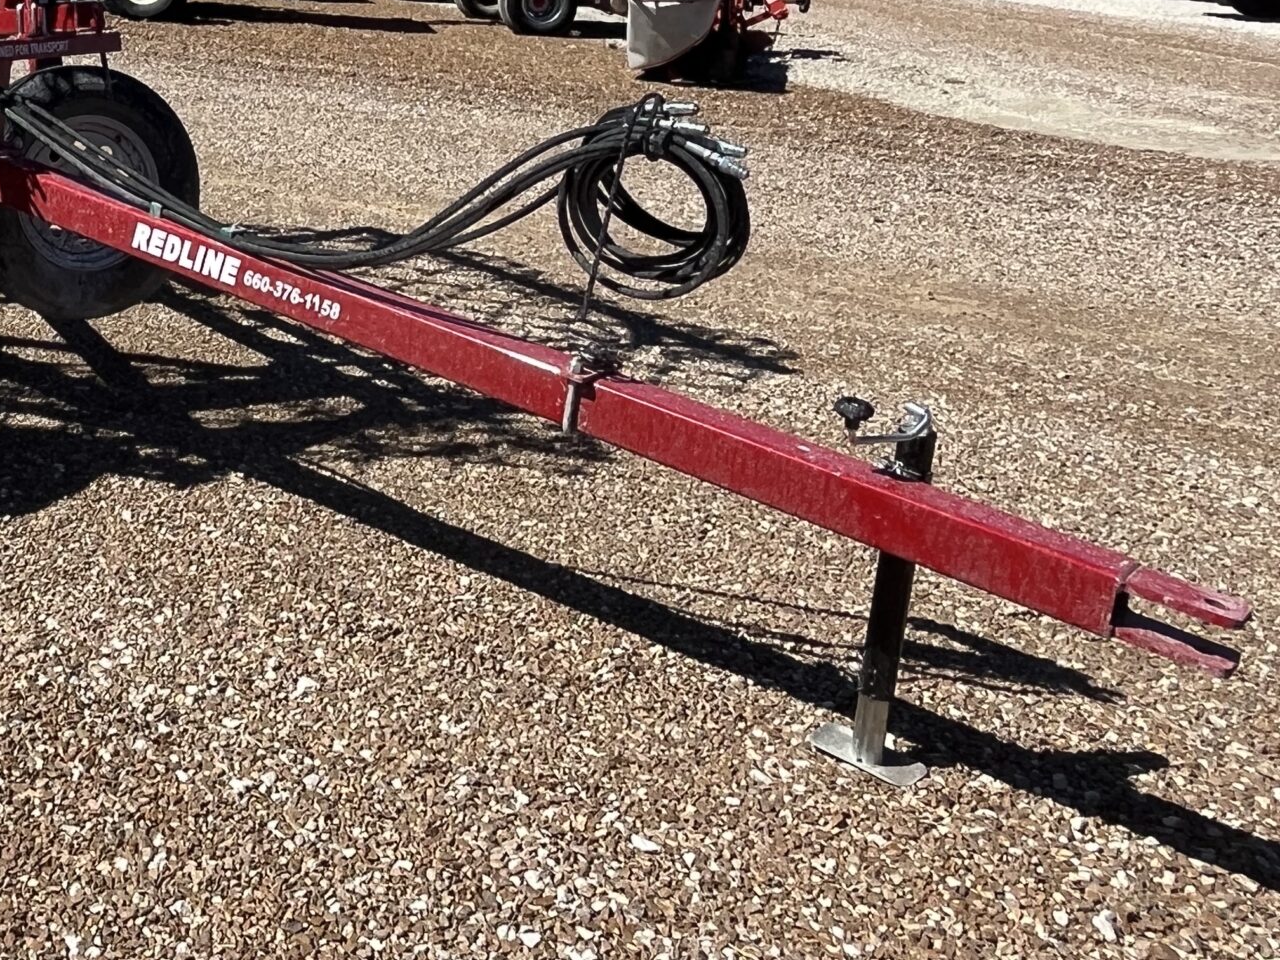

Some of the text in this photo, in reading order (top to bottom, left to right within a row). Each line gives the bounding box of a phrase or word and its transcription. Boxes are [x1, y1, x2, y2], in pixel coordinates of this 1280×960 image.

[15, 43, 30, 55] FOR
[30, 40, 69, 54] TRANSPORT
[131, 222, 341, 320] REDLINE 660-376-1158
